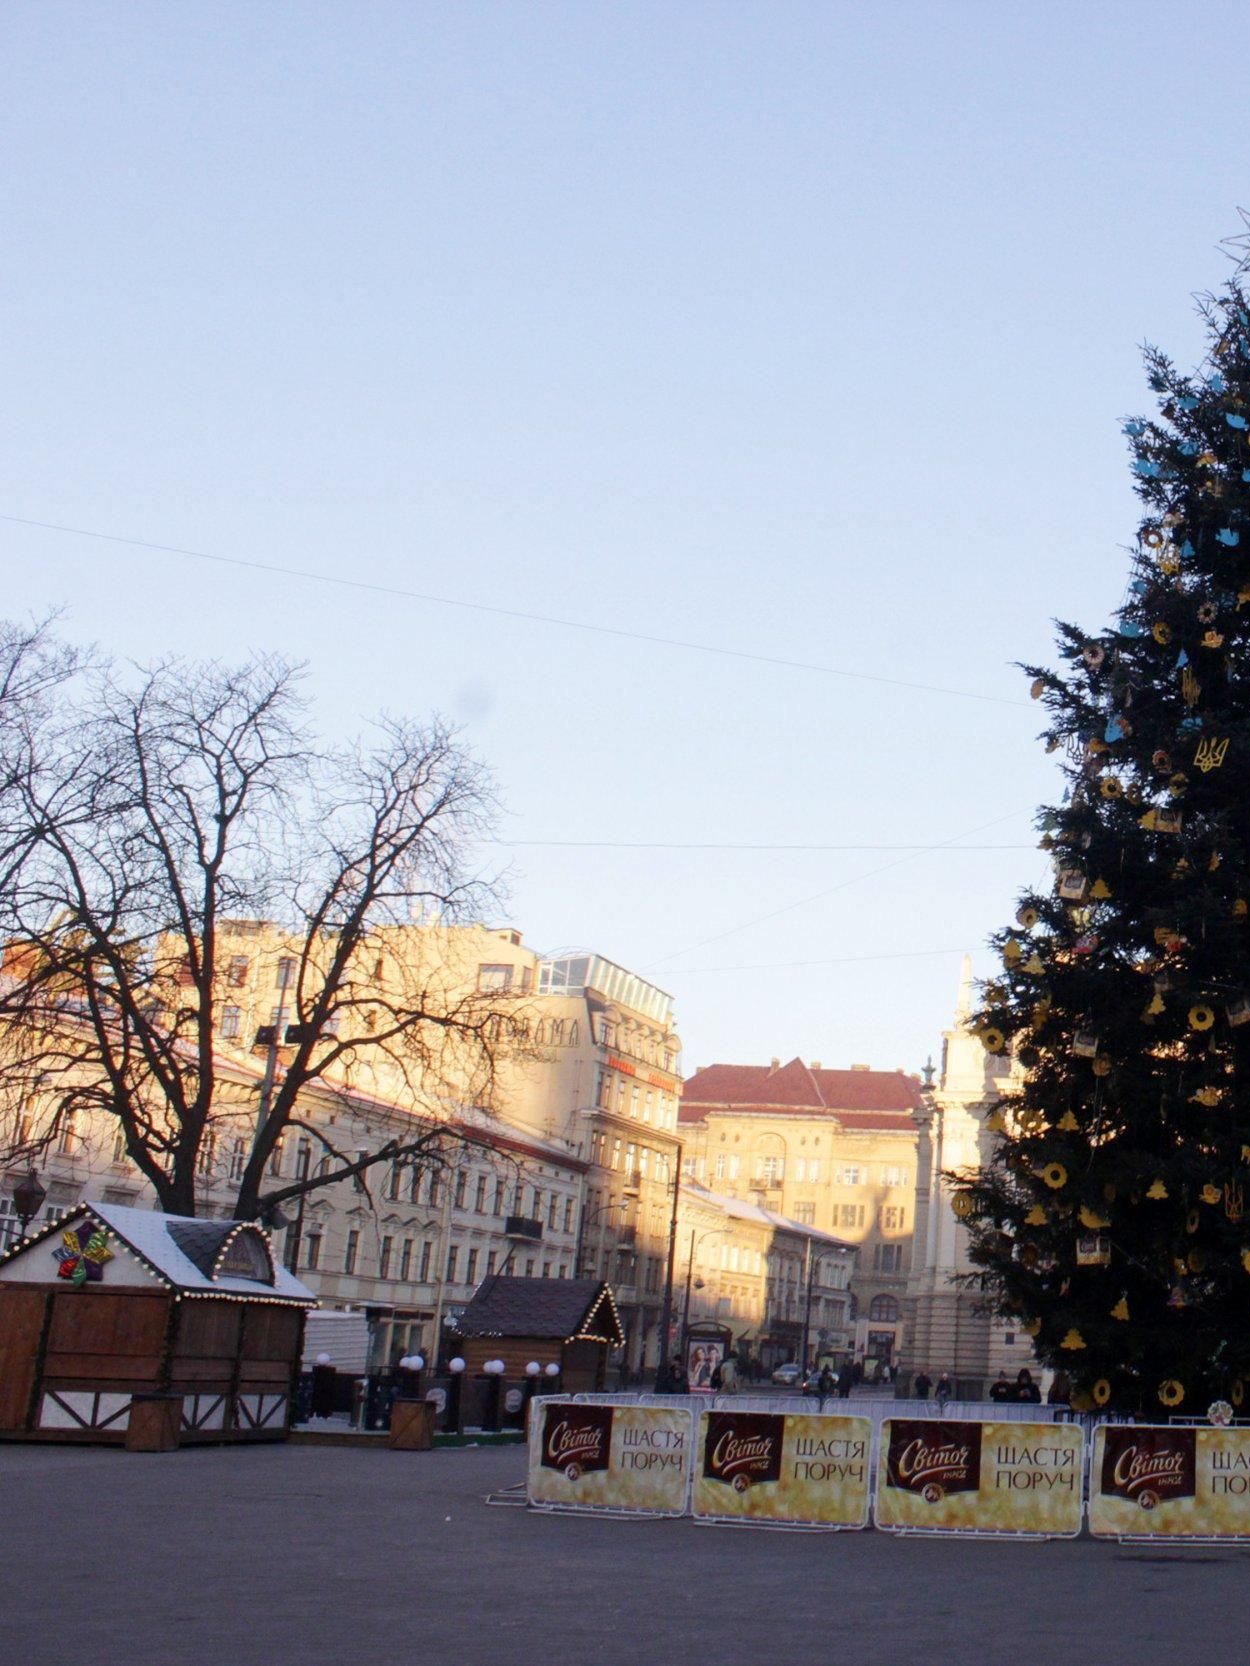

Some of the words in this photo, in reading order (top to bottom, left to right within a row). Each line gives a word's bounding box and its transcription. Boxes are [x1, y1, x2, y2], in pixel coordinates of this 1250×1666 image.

[623, 1428, 685, 1449] ЩАСТЯ
[796, 1438, 865, 1459] ЩАСТЯ
[621, 1451, 683, 1472] ПОРУЧ
[899, 1439, 969, 1477] Світоч
[997, 1446, 1075, 1466] ЩАСТЯ
[1114, 1446, 1184, 1486] Світоч
[794, 1461, 863, 1482] ПОРУЧ
[996, 1470, 1074, 1491] ПОРУЧ
